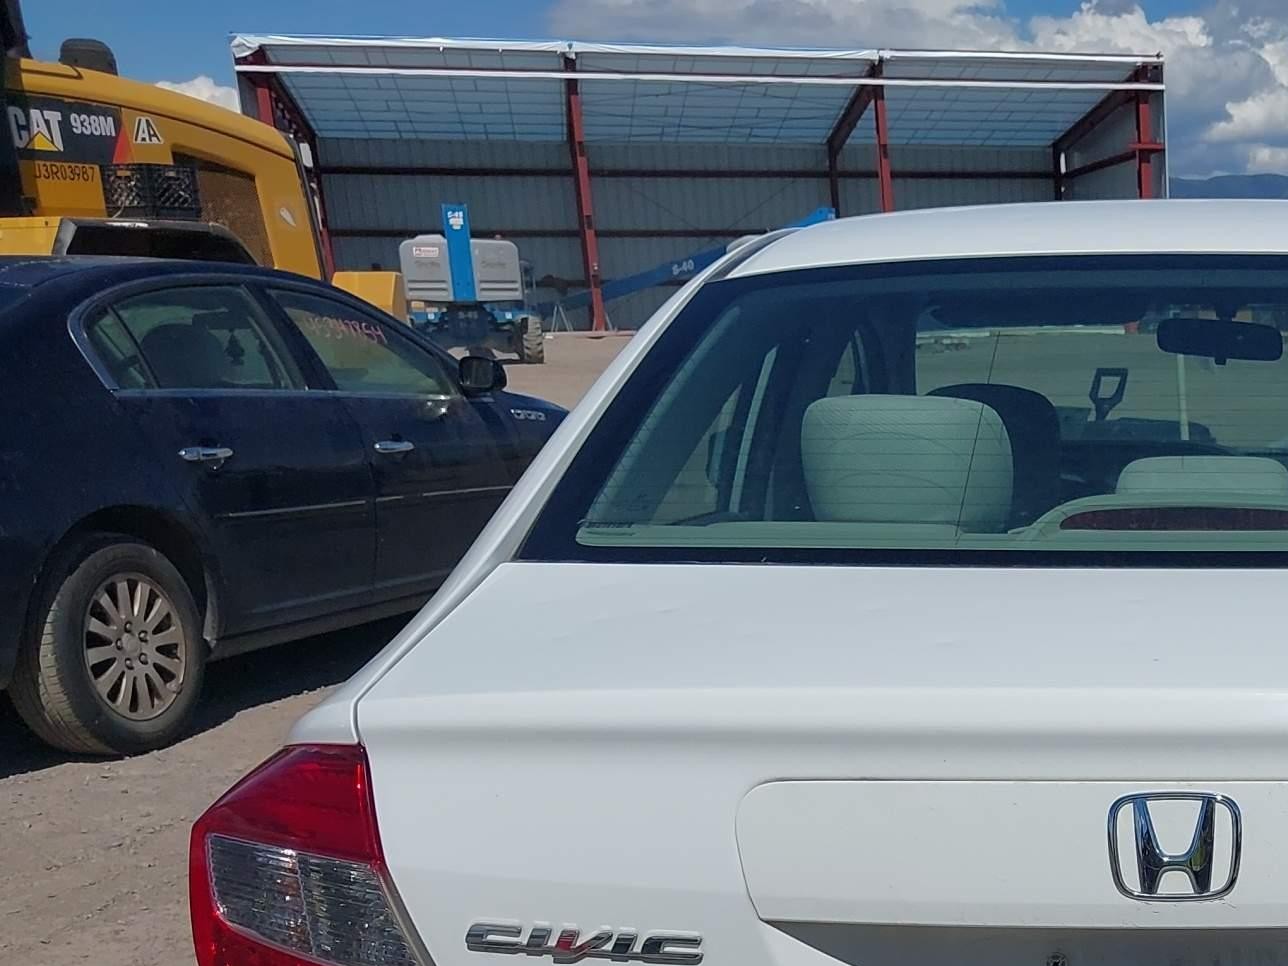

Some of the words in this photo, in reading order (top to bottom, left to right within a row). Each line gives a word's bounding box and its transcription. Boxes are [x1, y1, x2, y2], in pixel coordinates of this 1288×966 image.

[7, 106, 64, 152] CAT
[70, 113, 116, 137] 938M
[671, 259, 695, 276] S-40
[465, 922, 703, 965] CIVIC
